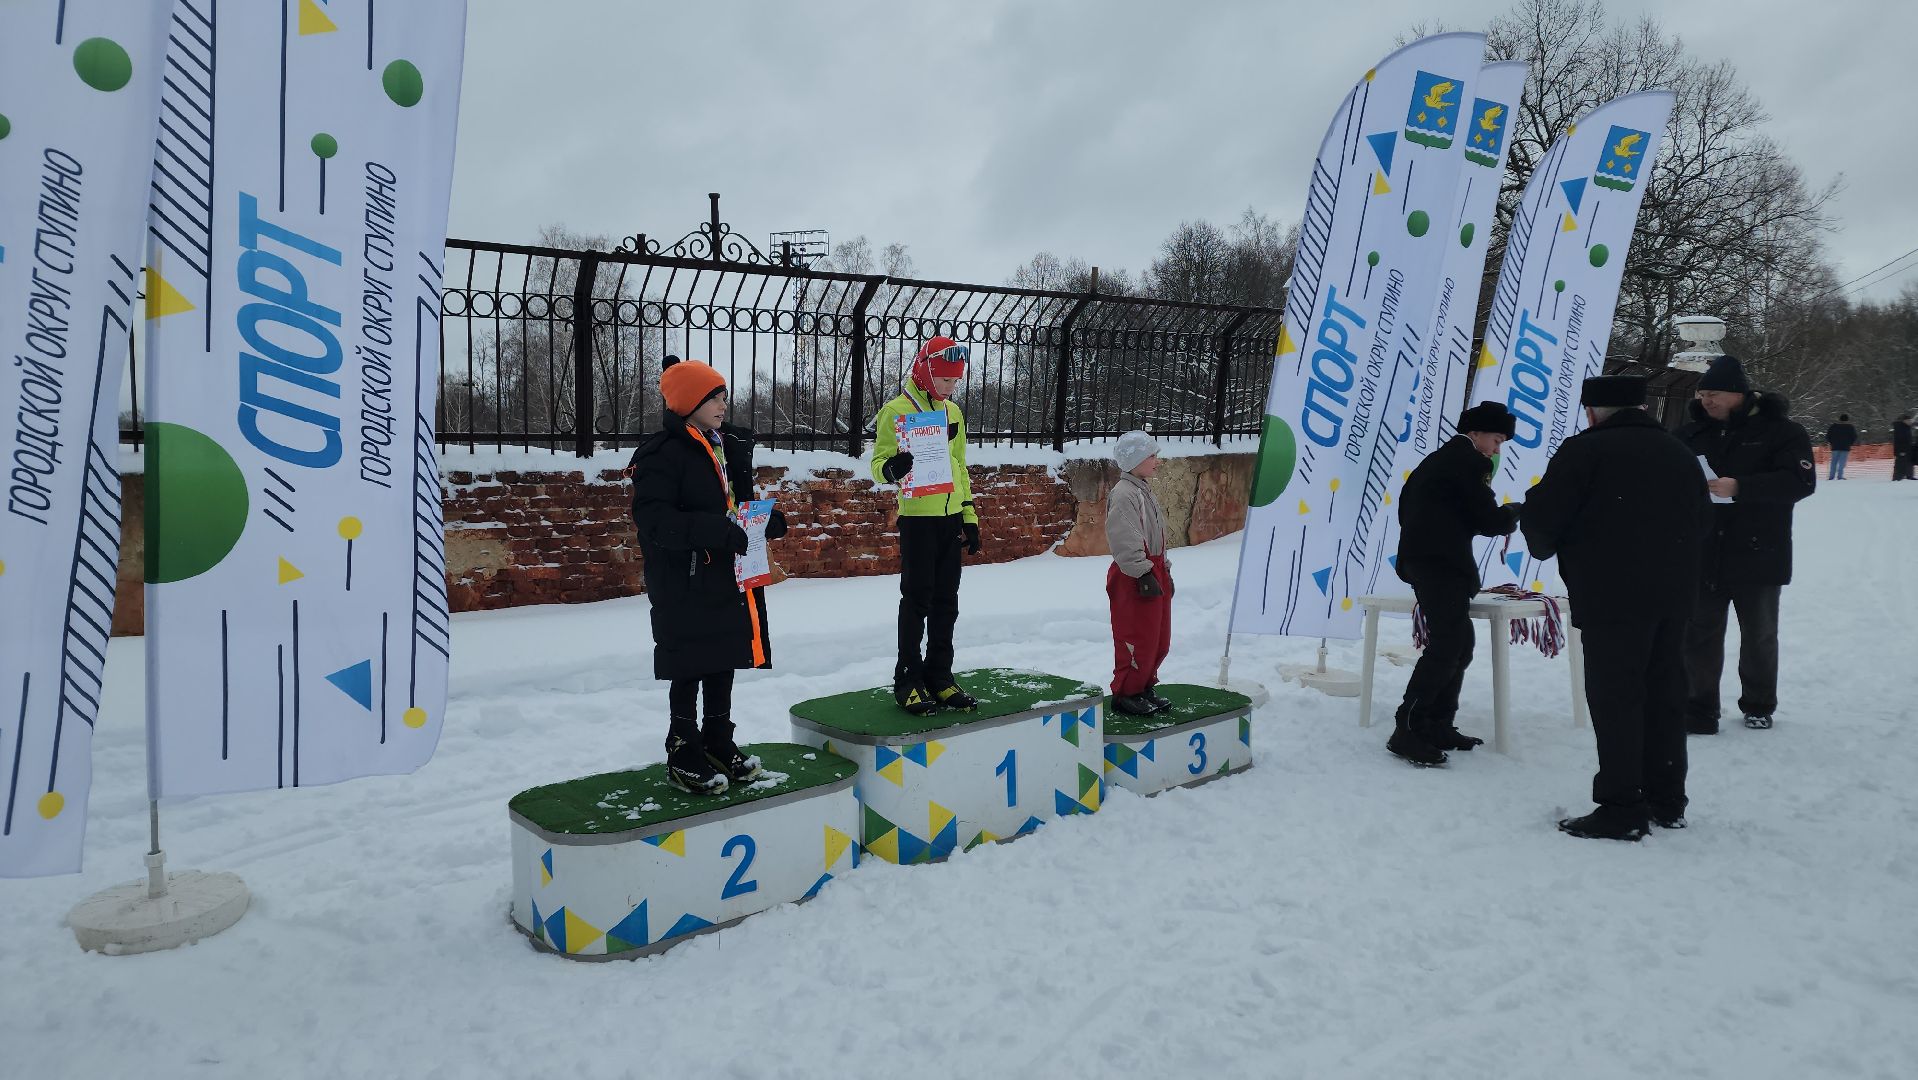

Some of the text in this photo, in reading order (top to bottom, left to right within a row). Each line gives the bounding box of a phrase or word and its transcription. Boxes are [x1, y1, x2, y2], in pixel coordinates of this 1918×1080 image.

[8, 148, 83, 525] ГОРОДСКОЙ ОКРУГ СТУПИНО
[237, 191, 343, 468] СПОРТ
[355, 162, 397, 488] ГОРОДСКОЙ ОКРУГ СТУПИНО
[1301, 284, 1366, 447] СПОРТ
[1344, 268, 1404, 464] ГОРОДСКОЙ ОКРУГ СТУПИНО
[1414, 277, 1455, 456] ГОРОДСКОЙ ОКРУГ СТУПИНО
[1507, 308, 1558, 449] СПОРТ
[1559, 347, 1577, 388] ОКРУГ
[1566, 294, 1586, 351] СТУПИНО
[995, 749, 1017, 807] 1
[1188, 732, 1207, 774] 3
[721, 834, 757, 900] 2
